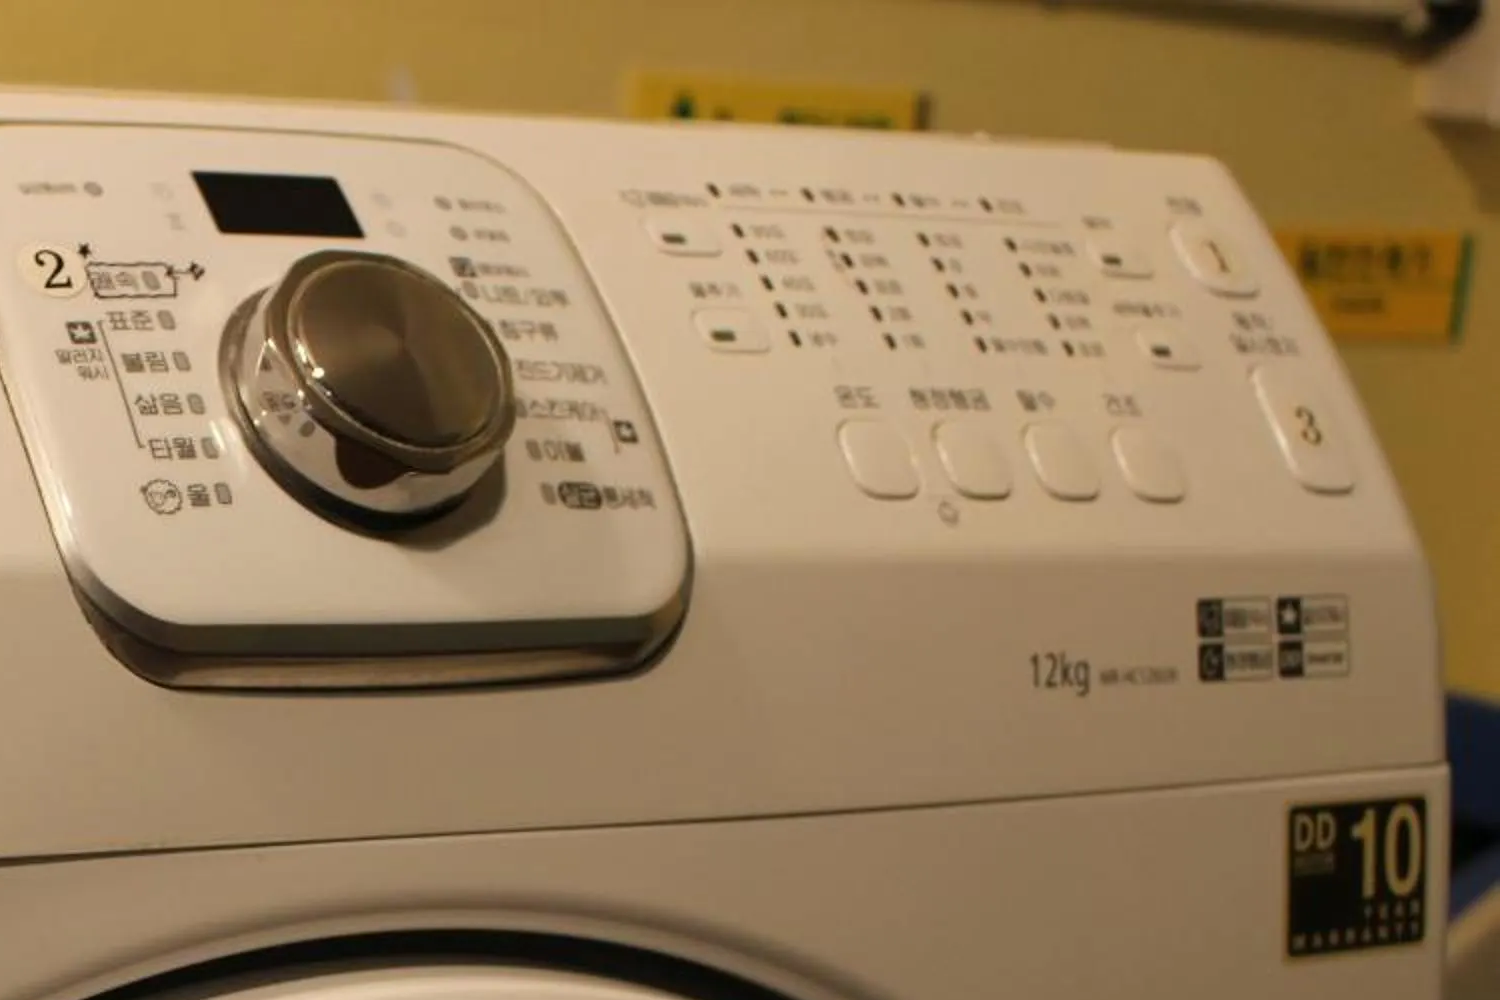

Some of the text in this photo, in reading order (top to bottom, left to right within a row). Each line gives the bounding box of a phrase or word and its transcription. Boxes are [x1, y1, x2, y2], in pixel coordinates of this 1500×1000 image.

[34, 249, 73, 289] 2
[1206, 240, 1229, 273] 1
[106, 310, 155, 331] 표준
[1295, 406, 1322, 446] 3
[148, 437, 198, 460] 타월
[187, 483, 212, 507] 울
[1030, 651, 1091, 697] 12kg
[1294, 802, 1422, 899] DD 10
